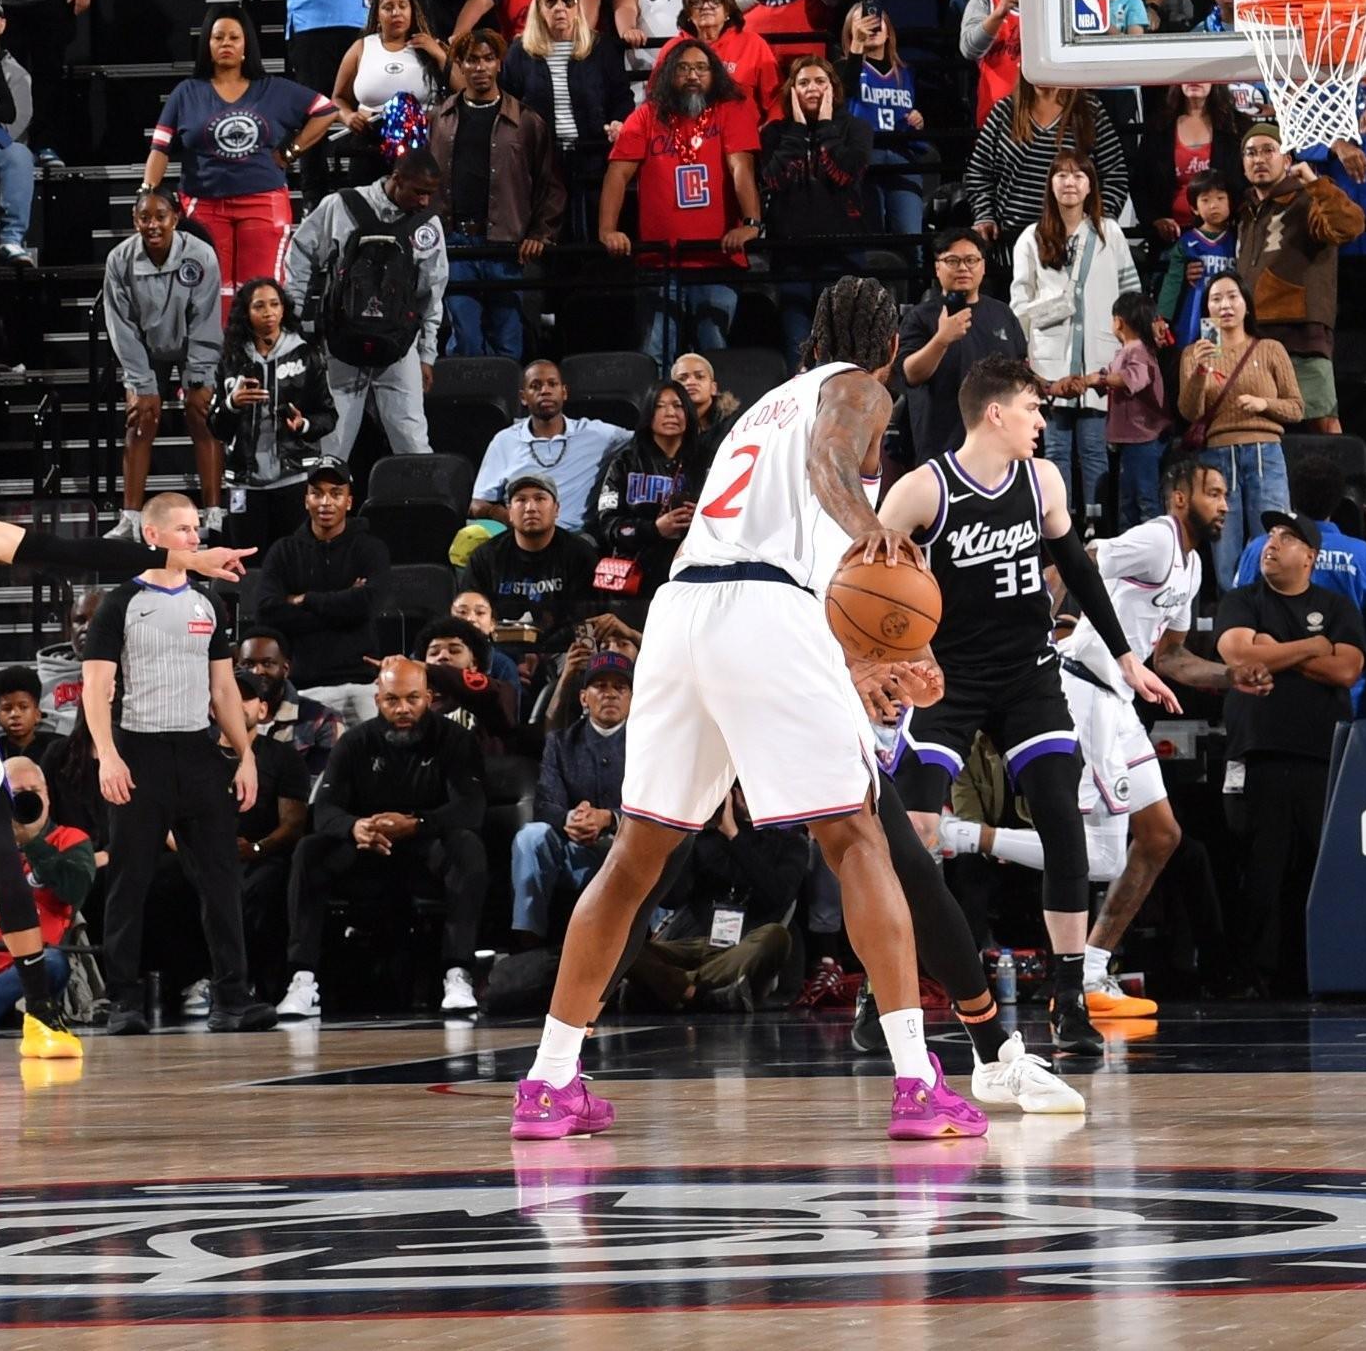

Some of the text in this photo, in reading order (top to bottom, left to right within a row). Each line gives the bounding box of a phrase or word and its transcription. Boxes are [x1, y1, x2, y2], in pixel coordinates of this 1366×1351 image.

[1077, 14, 1097, 28] NBA
[860, 82, 913, 110] CLIPPERS
[877, 107, 895, 131] 13
[700, 444, 761, 520] 2
[947, 519, 1037, 569] Kings
[994, 557, 1042, 599] 33
